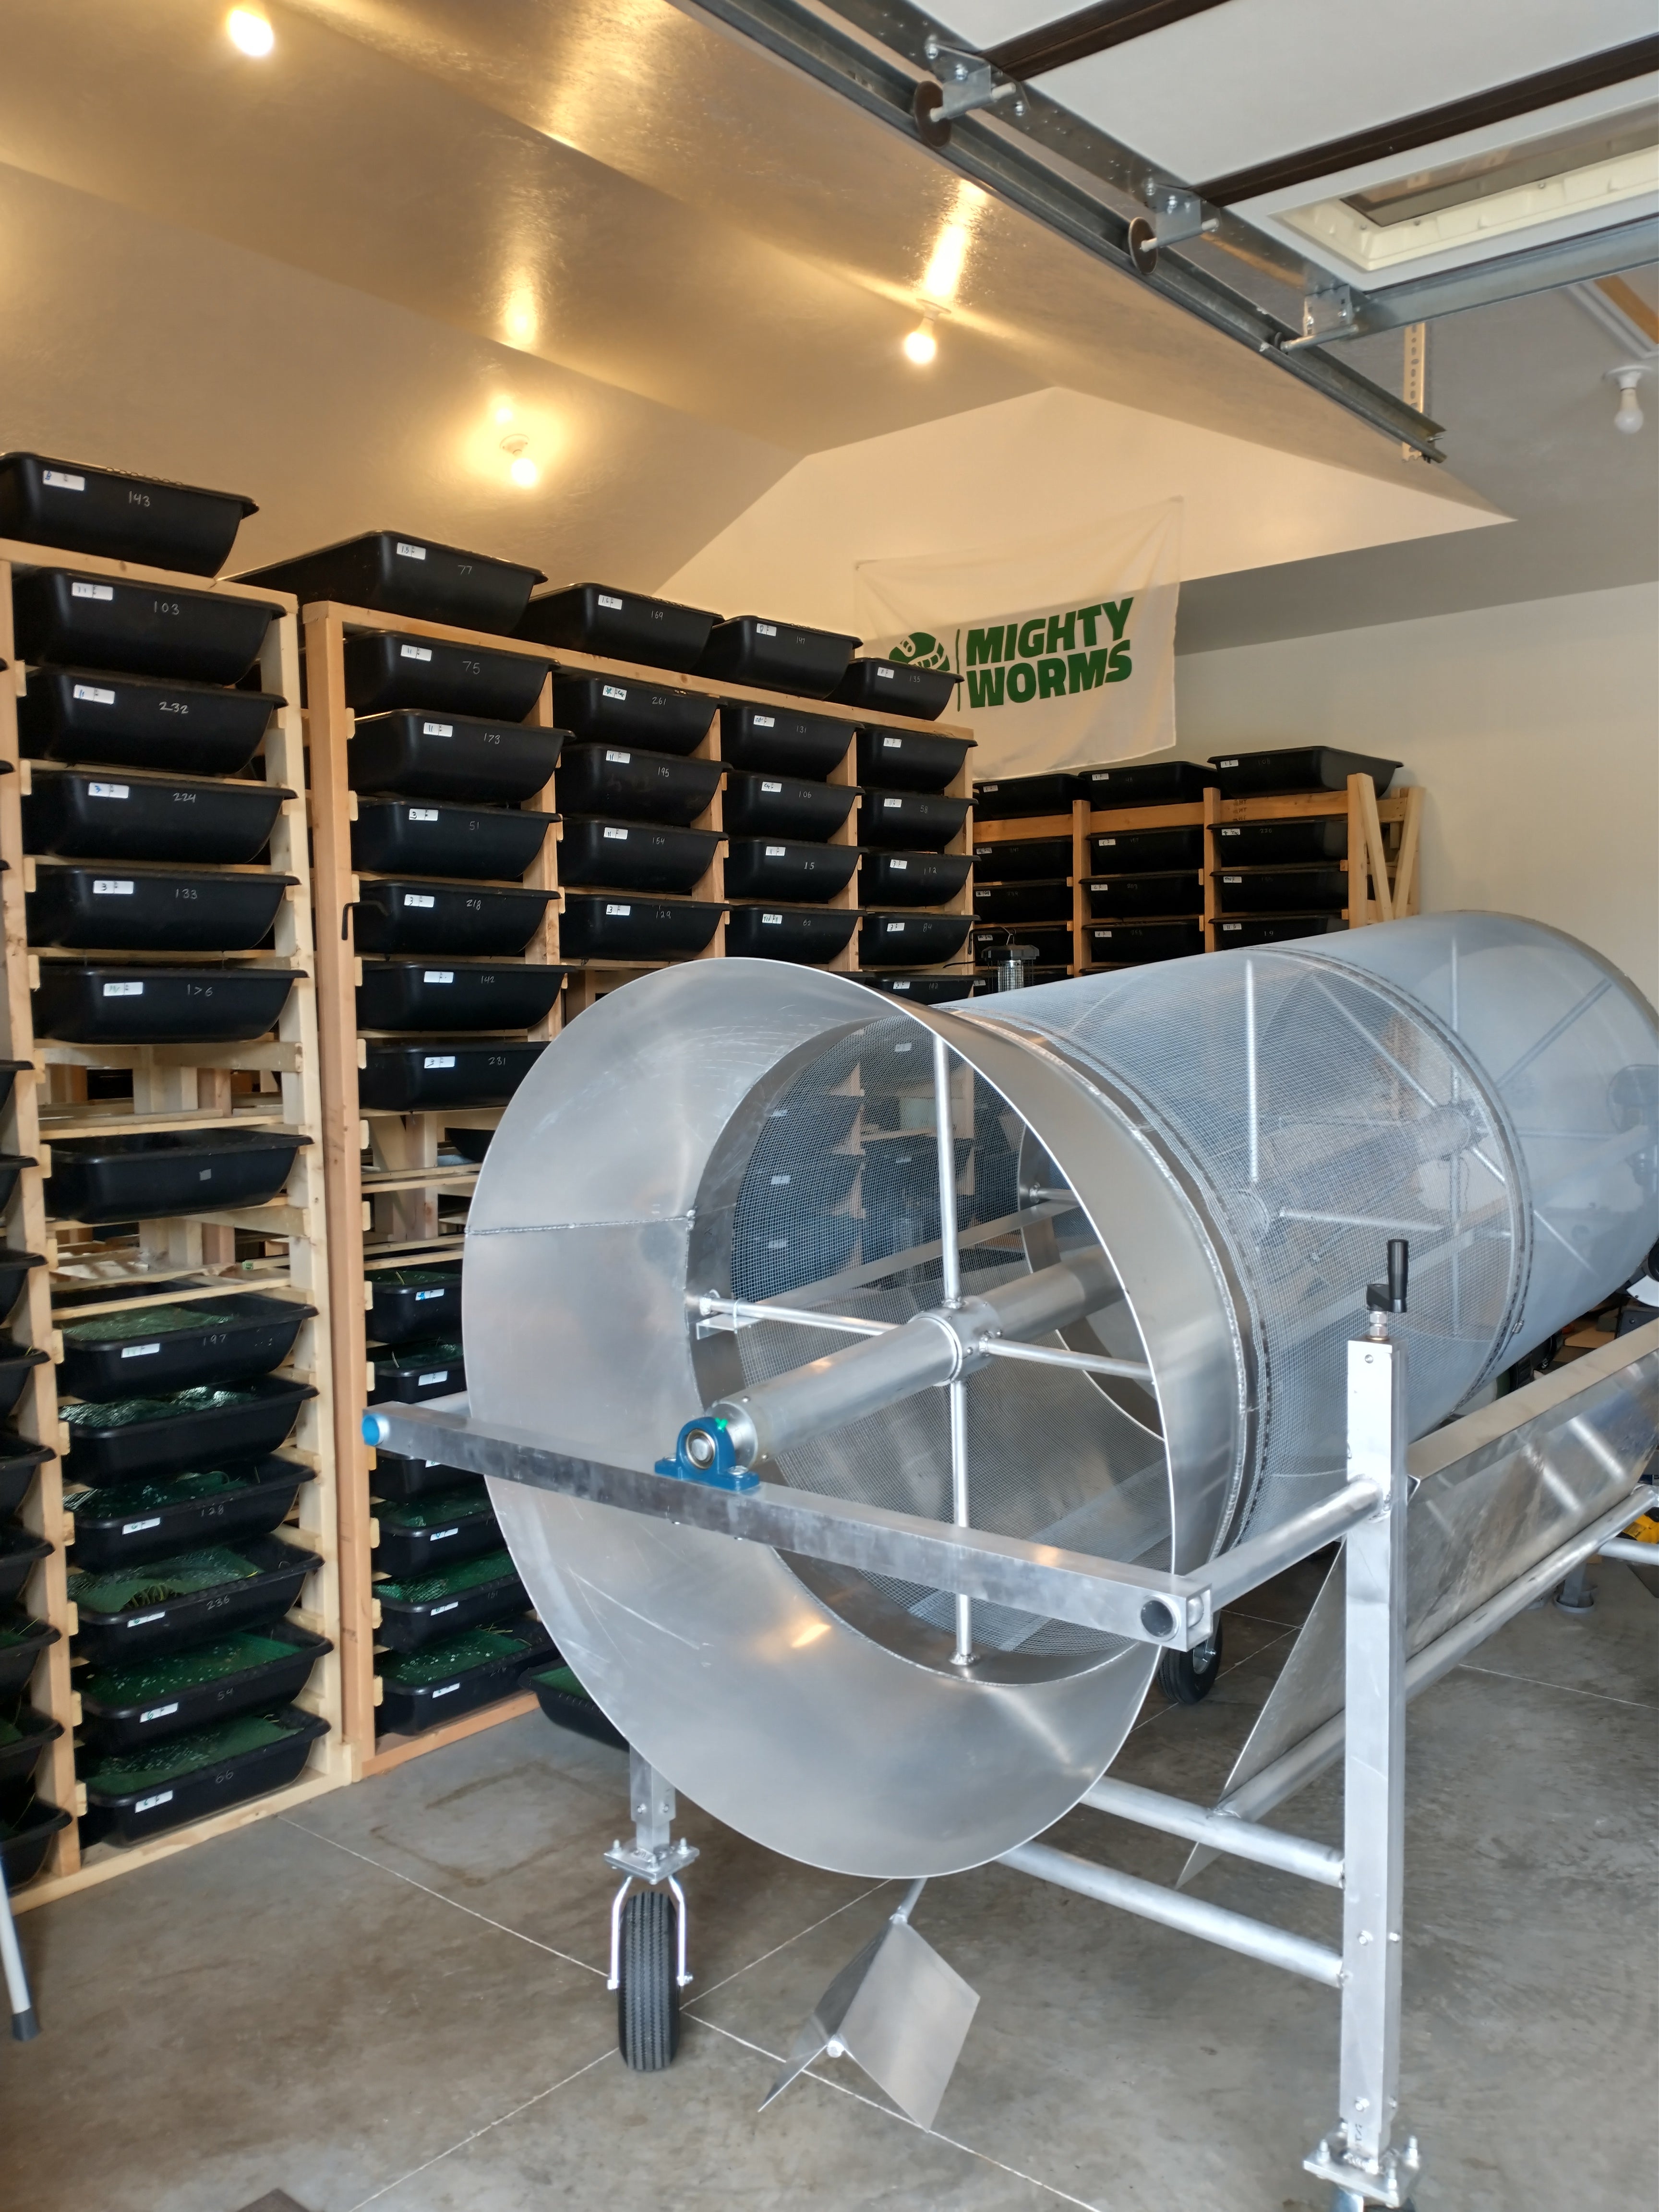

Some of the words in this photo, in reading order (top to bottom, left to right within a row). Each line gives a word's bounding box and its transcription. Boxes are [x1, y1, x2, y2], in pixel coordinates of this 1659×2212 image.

[128, 491, 150, 507] 143
[457, 565, 472, 576] 77
[154, 601, 180, 615] 103
[651, 610, 664, 621] 169
[966, 597, 1134, 666] MIGHTY
[462, 661, 480, 674] 75
[966, 639, 1132, 708] WORMS
[159, 701, 189, 714] 232
[651, 697, 666, 706] 261
[796, 725, 806, 733] 131
[484, 733, 501, 745] 173
[658, 766, 670, 777] 195
[173, 793, 196, 803] 224
[799, 791, 812, 799] 106
[469, 820, 479, 830] 51
[804, 861, 815, 870] 15
[175, 888, 197, 900] 133
[466, 899, 481, 911] 218
[488, 1057, 506, 1066] 231
[203, 1334, 227, 1346] 197
[206, 1595, 230, 1610] 236
[217, 1688, 233, 1701] 54
[215, 1770, 234, 1784] 66
